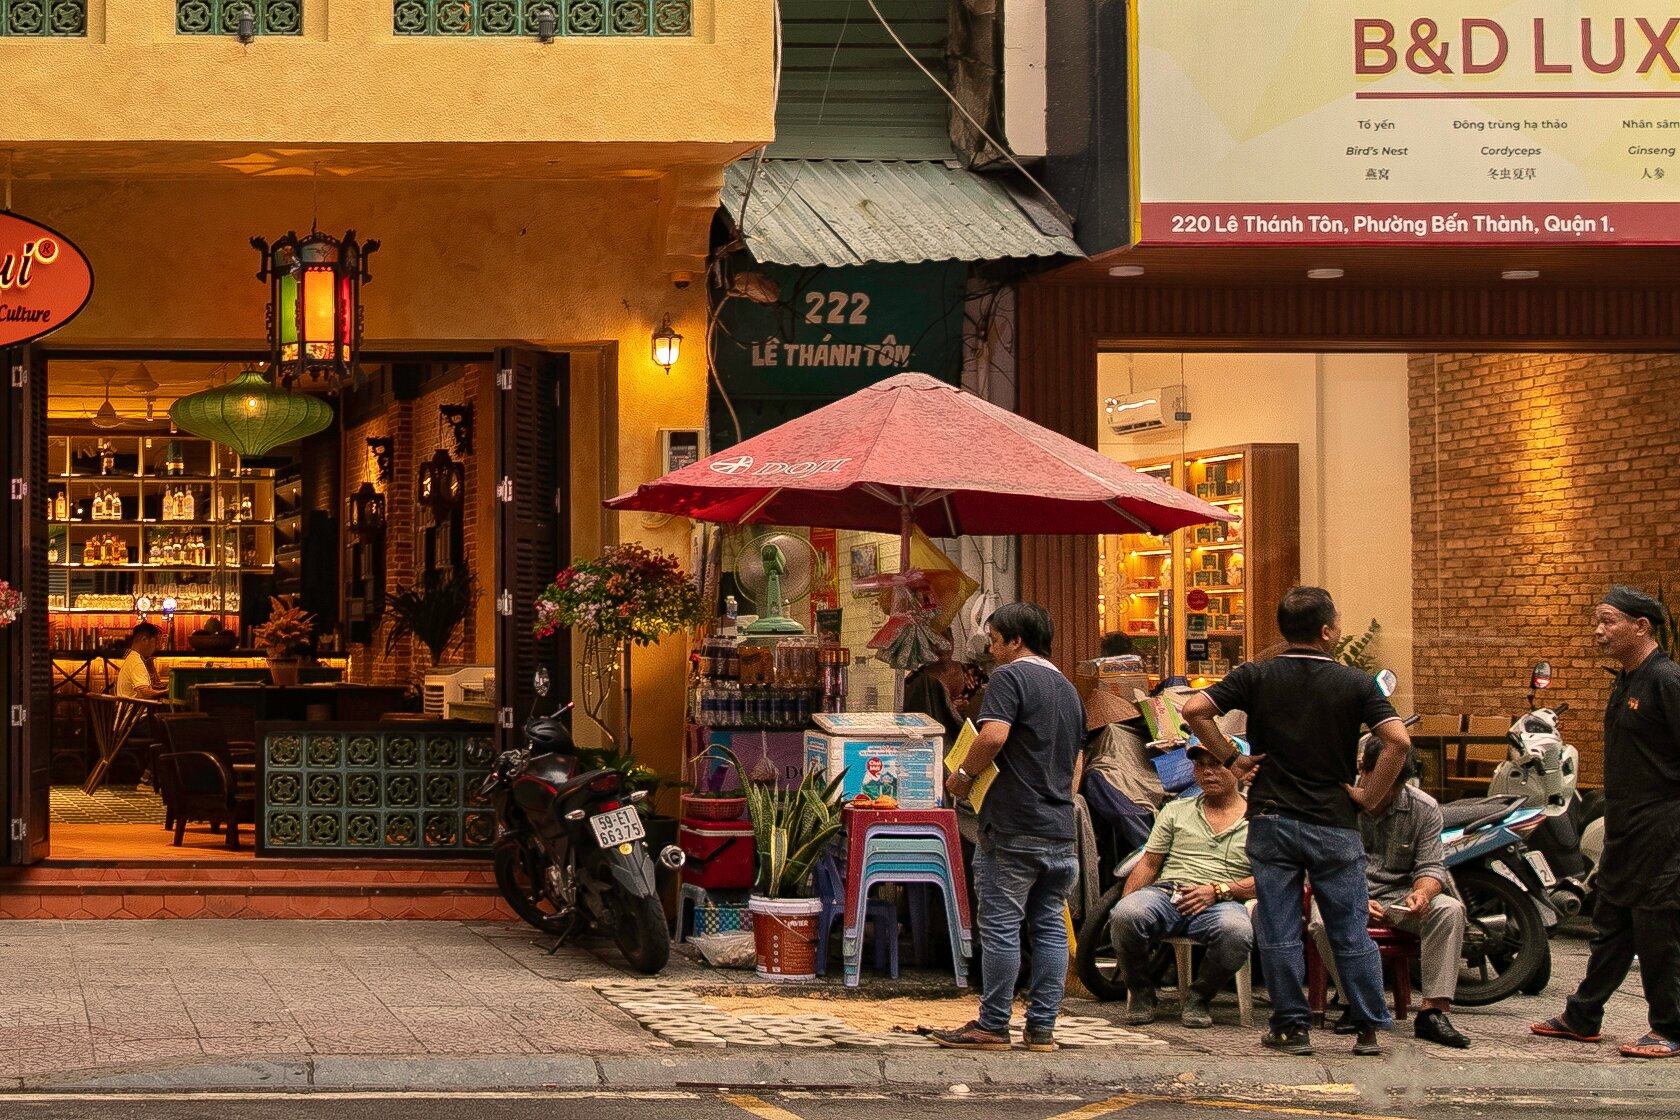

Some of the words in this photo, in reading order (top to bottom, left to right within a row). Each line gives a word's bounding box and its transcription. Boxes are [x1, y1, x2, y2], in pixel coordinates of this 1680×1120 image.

[1354, 17, 1509, 75] B&D
[1533, 17, 1680, 75] LUX
[1381, 147, 1409, 156] Nest
[1480, 146, 1542, 157] Cordyceps
[1628, 145, 1676, 158] Ginseng
[1171, 215, 1209, 233] 220
[1214, 215, 1239, 233] Lê
[1242, 215, 1304, 233] Thánh
[1308, 215, 1350, 235] Tôn,
[1353, 214, 1427, 236] Phường
[1431, 213, 1469, 233] Bến
[1472, 215, 1539, 235] Thành,
[1543, 215, 1596, 237] Quận
[1600, 215, 1615, 233] 1.
[805, 291, 870, 325] 222
[784, 334, 862, 368] THÁNH
[598, 810, 630, 831] 59-E1
